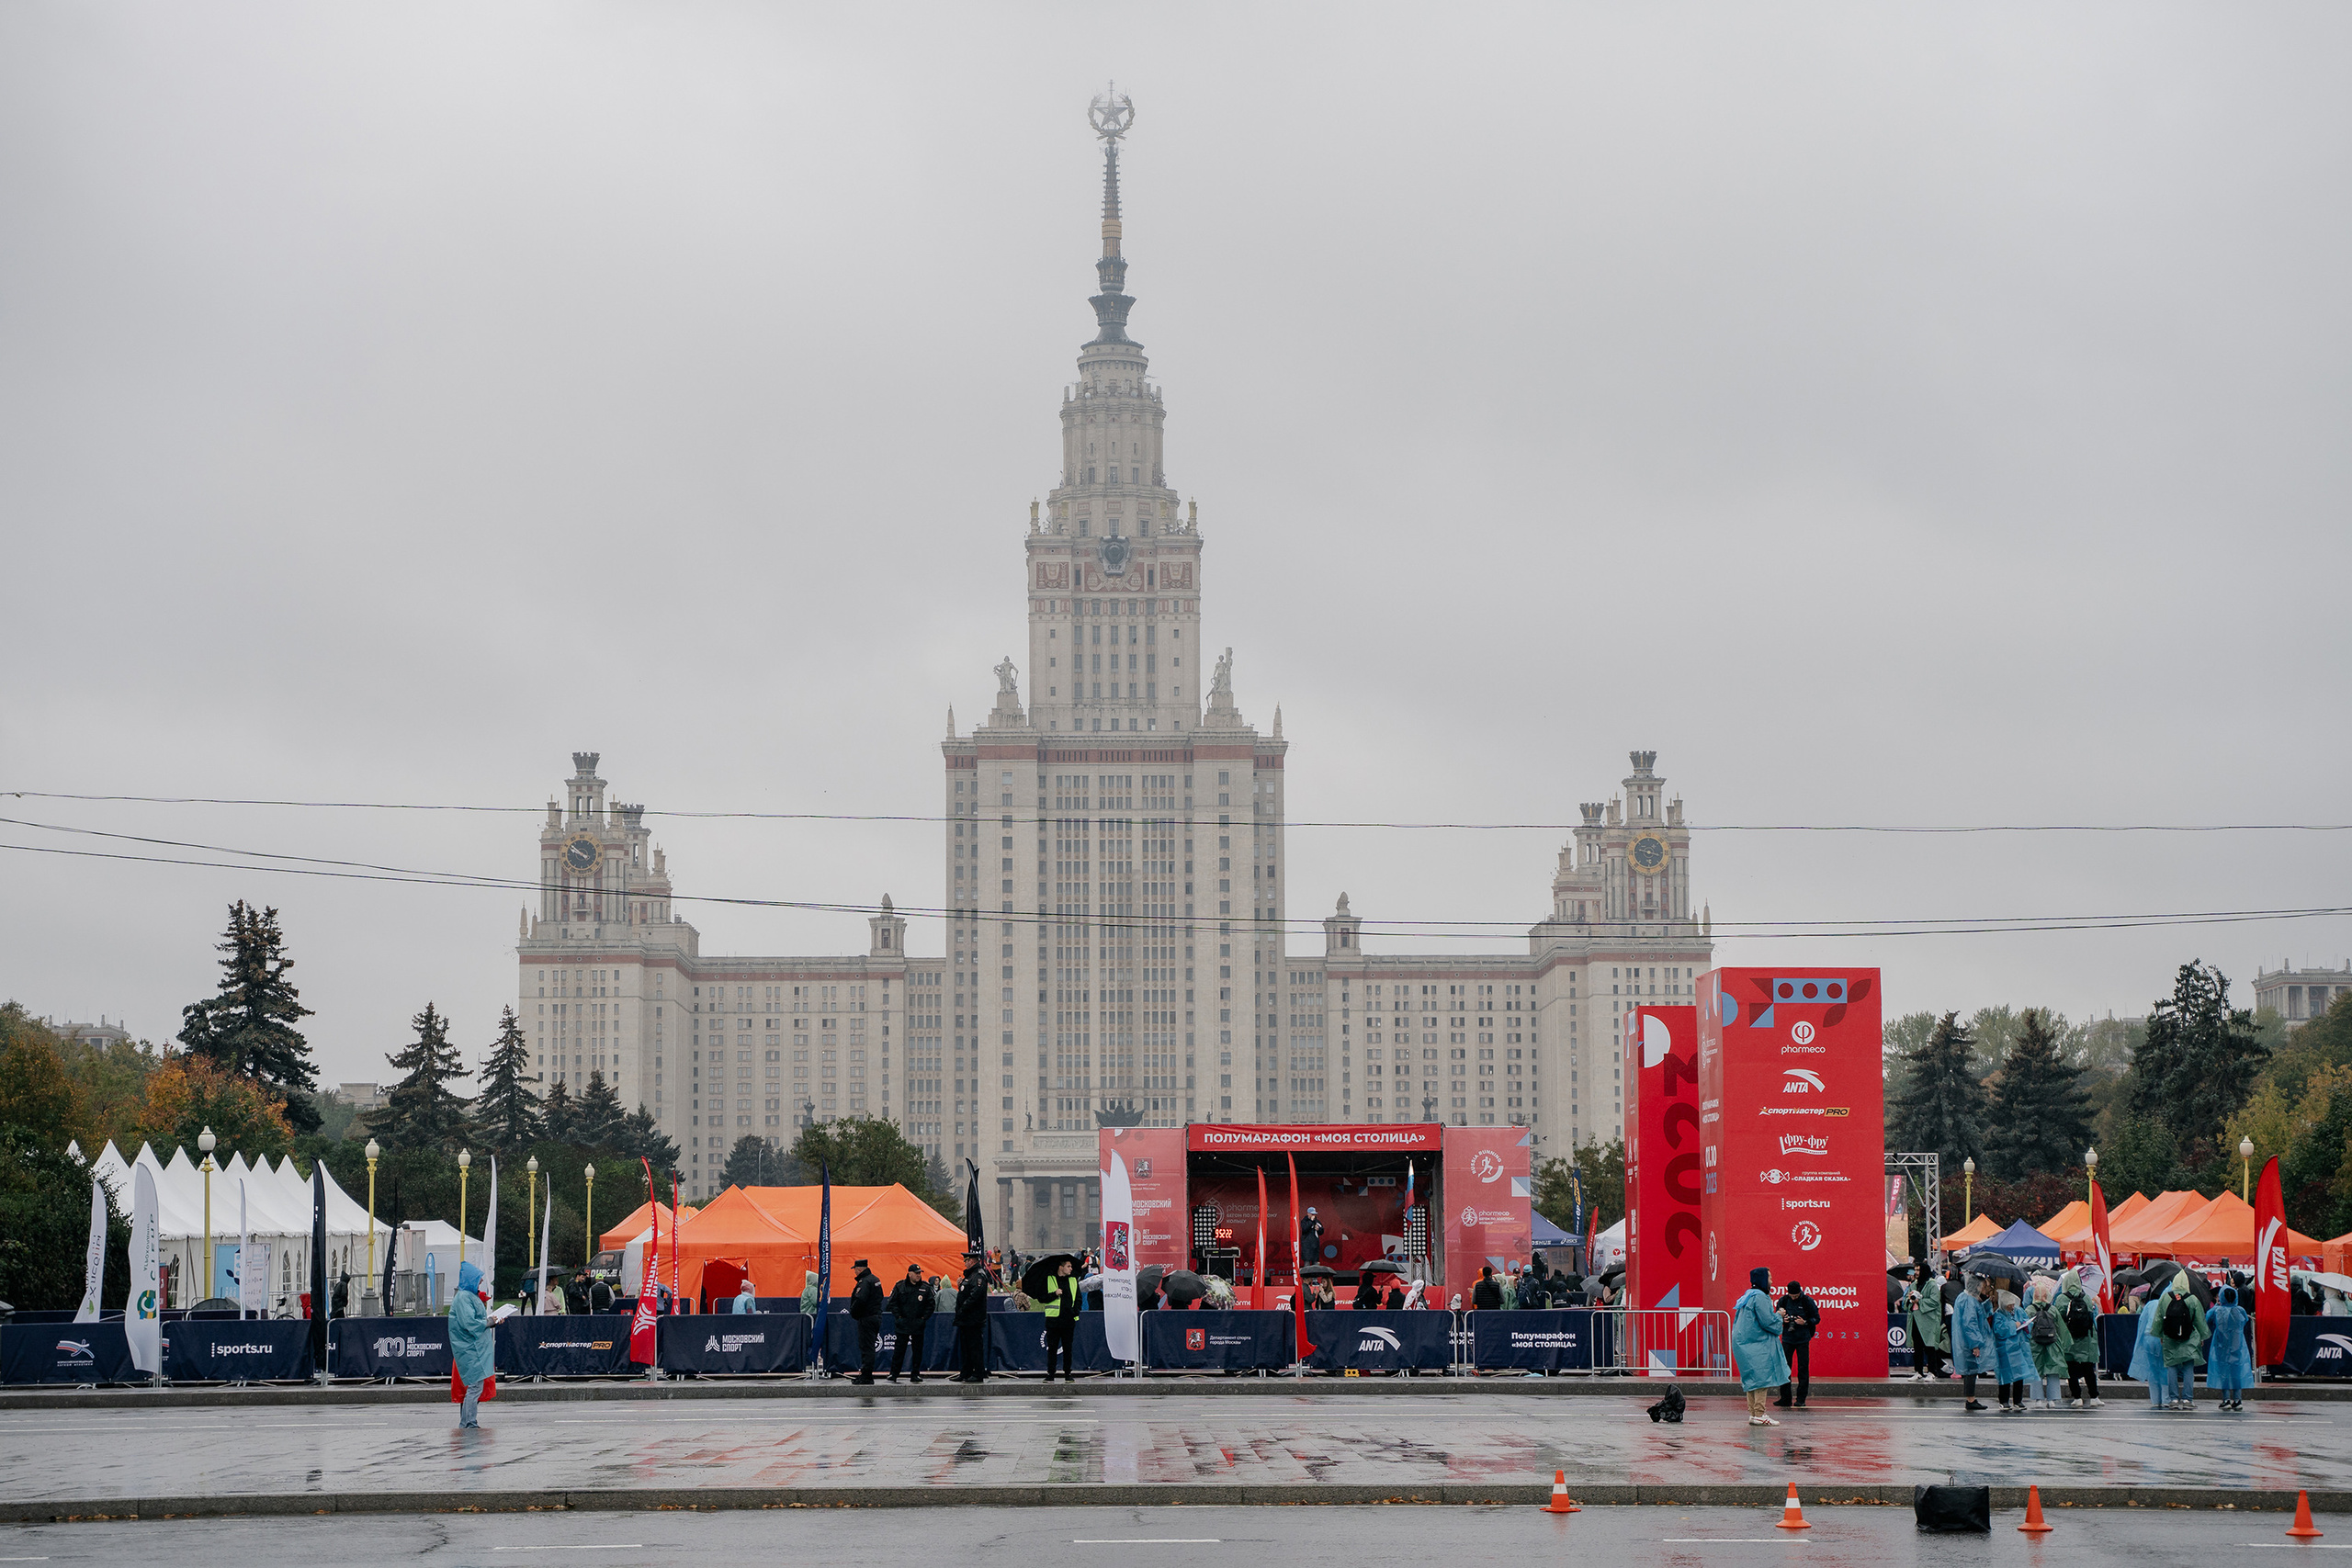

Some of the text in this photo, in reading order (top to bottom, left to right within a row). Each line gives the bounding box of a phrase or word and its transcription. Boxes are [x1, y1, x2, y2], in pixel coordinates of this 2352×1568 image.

[1781, 1044, 1826, 1055] pharmeco
[1783, 1082, 1809, 1093] ANTA
[1204, 1133, 1426, 1145] ПОЛУМАРАФОН «МОЯ СТОЛИЦА»
[1478, 1150, 1502, 1162] RUNNING
[1706, 1145, 1717, 1168] 01.10
[1706, 1172, 1717, 1194] 2023
[1131, 1198, 1172, 1208] МОСКОВСКИЙ
[1227, 1203, 1270, 1212] pharmeo
[1786, 1199, 1830, 1209] sports.ru
[2272, 1246, 2289, 1292] ANTA
[1769, 1287, 1856, 1296] ОЛАРАФОН
[1817, 1300, 1860, 1309] ОЛИЦА»
[722, 1333, 764, 1343] МОСКОВСКИЙ
[1512, 1332, 1576, 1340] Полумарафон
[217, 1343, 272, 1356] sports.ru
[373, 1337, 405, 1357] 100
[722, 1344, 742, 1352] СПОРТ
[1359, 1340, 1384, 1351] ANTA
[2316, 1347, 2342, 1358] ANTA
